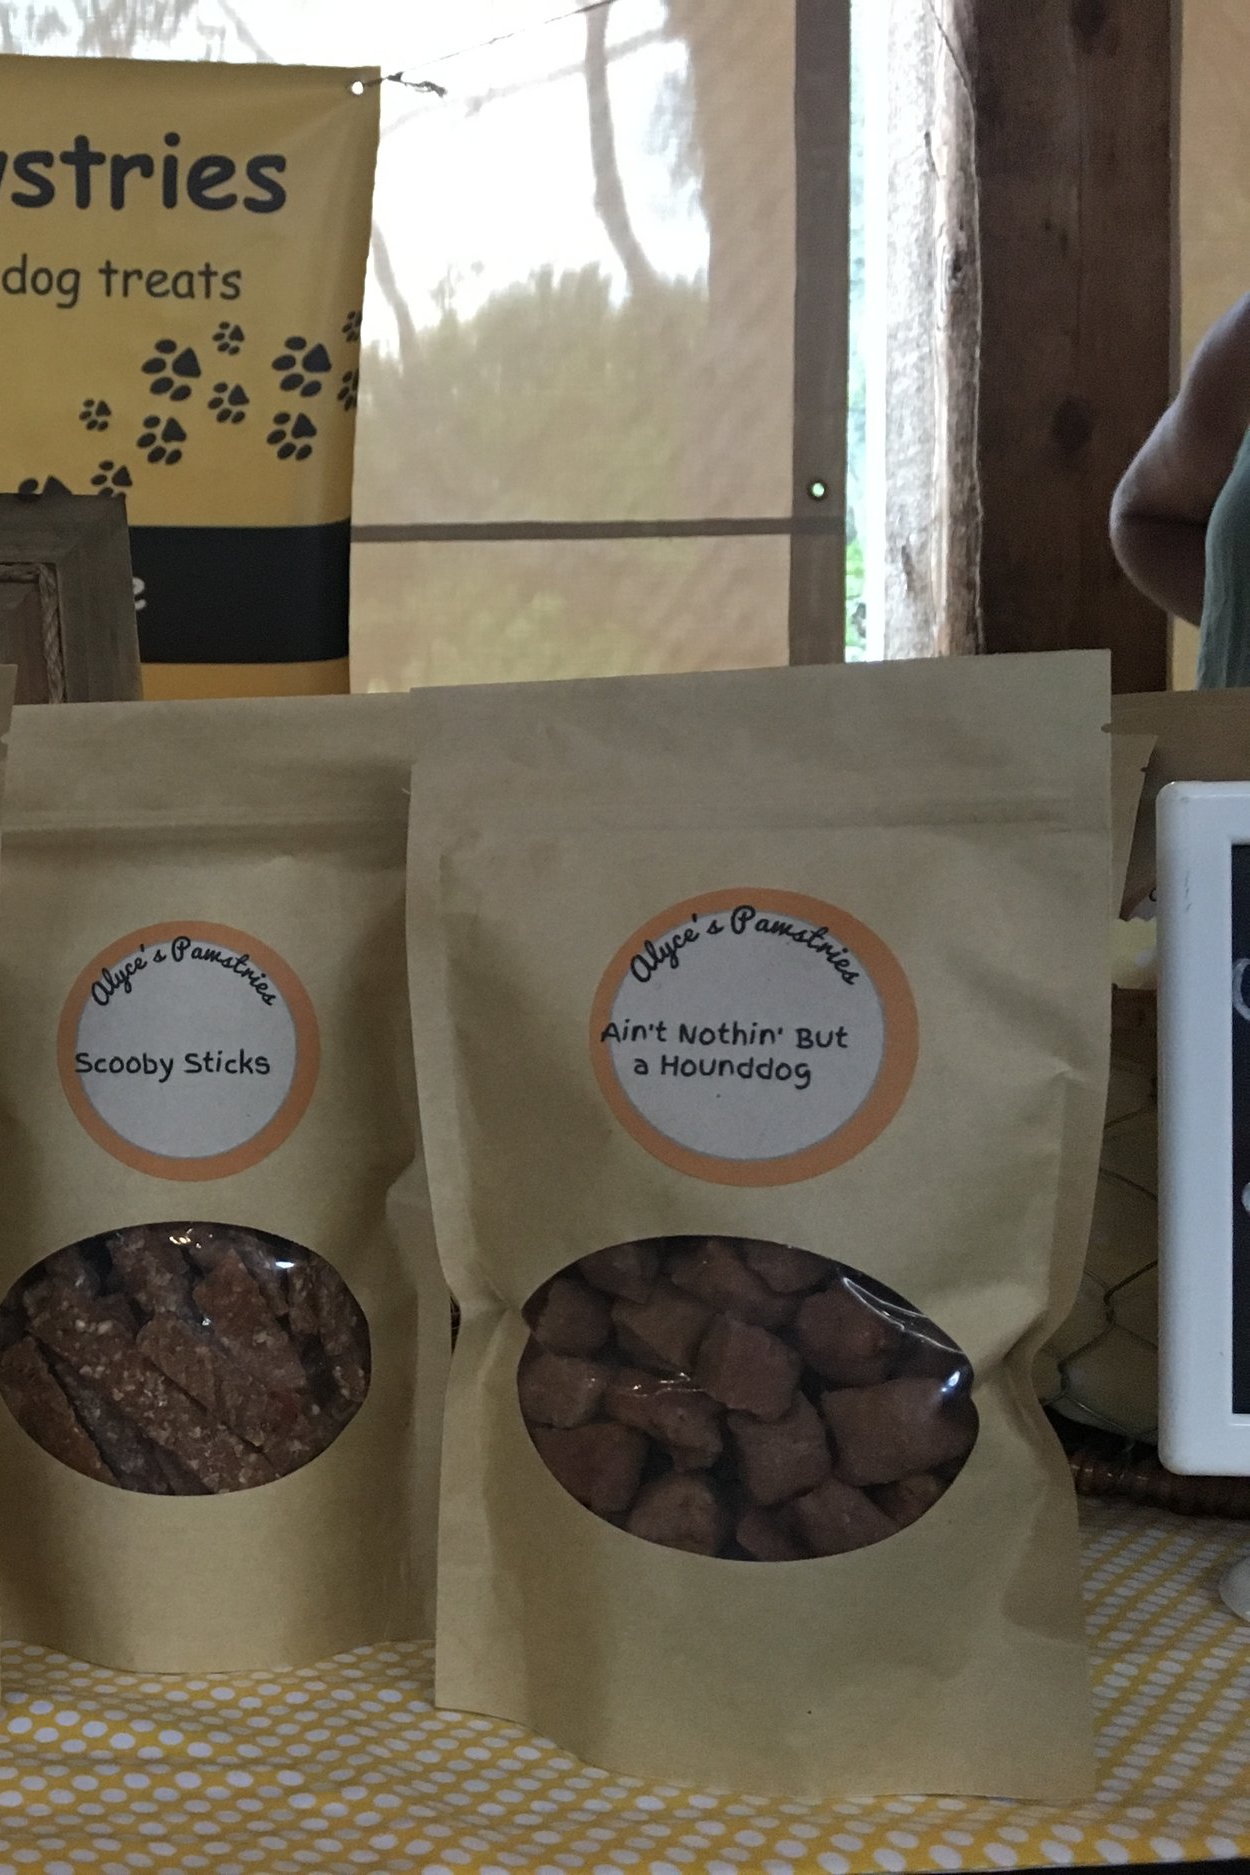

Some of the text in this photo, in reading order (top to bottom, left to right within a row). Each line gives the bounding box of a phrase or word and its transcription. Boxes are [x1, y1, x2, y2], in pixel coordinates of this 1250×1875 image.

[2, 253, 81, 309] dog
[98, 259, 242, 300] treats
[630, 905, 859, 985] Alyce's Pawstries
[91, 936, 276, 1006] Alyce's Pawstries
[600, 1018, 848, 1049] Ain't Nothin' But
[75, 1048, 271, 1083] Scooby Sticks
[633, 1054, 811, 1090] a Hounddog
